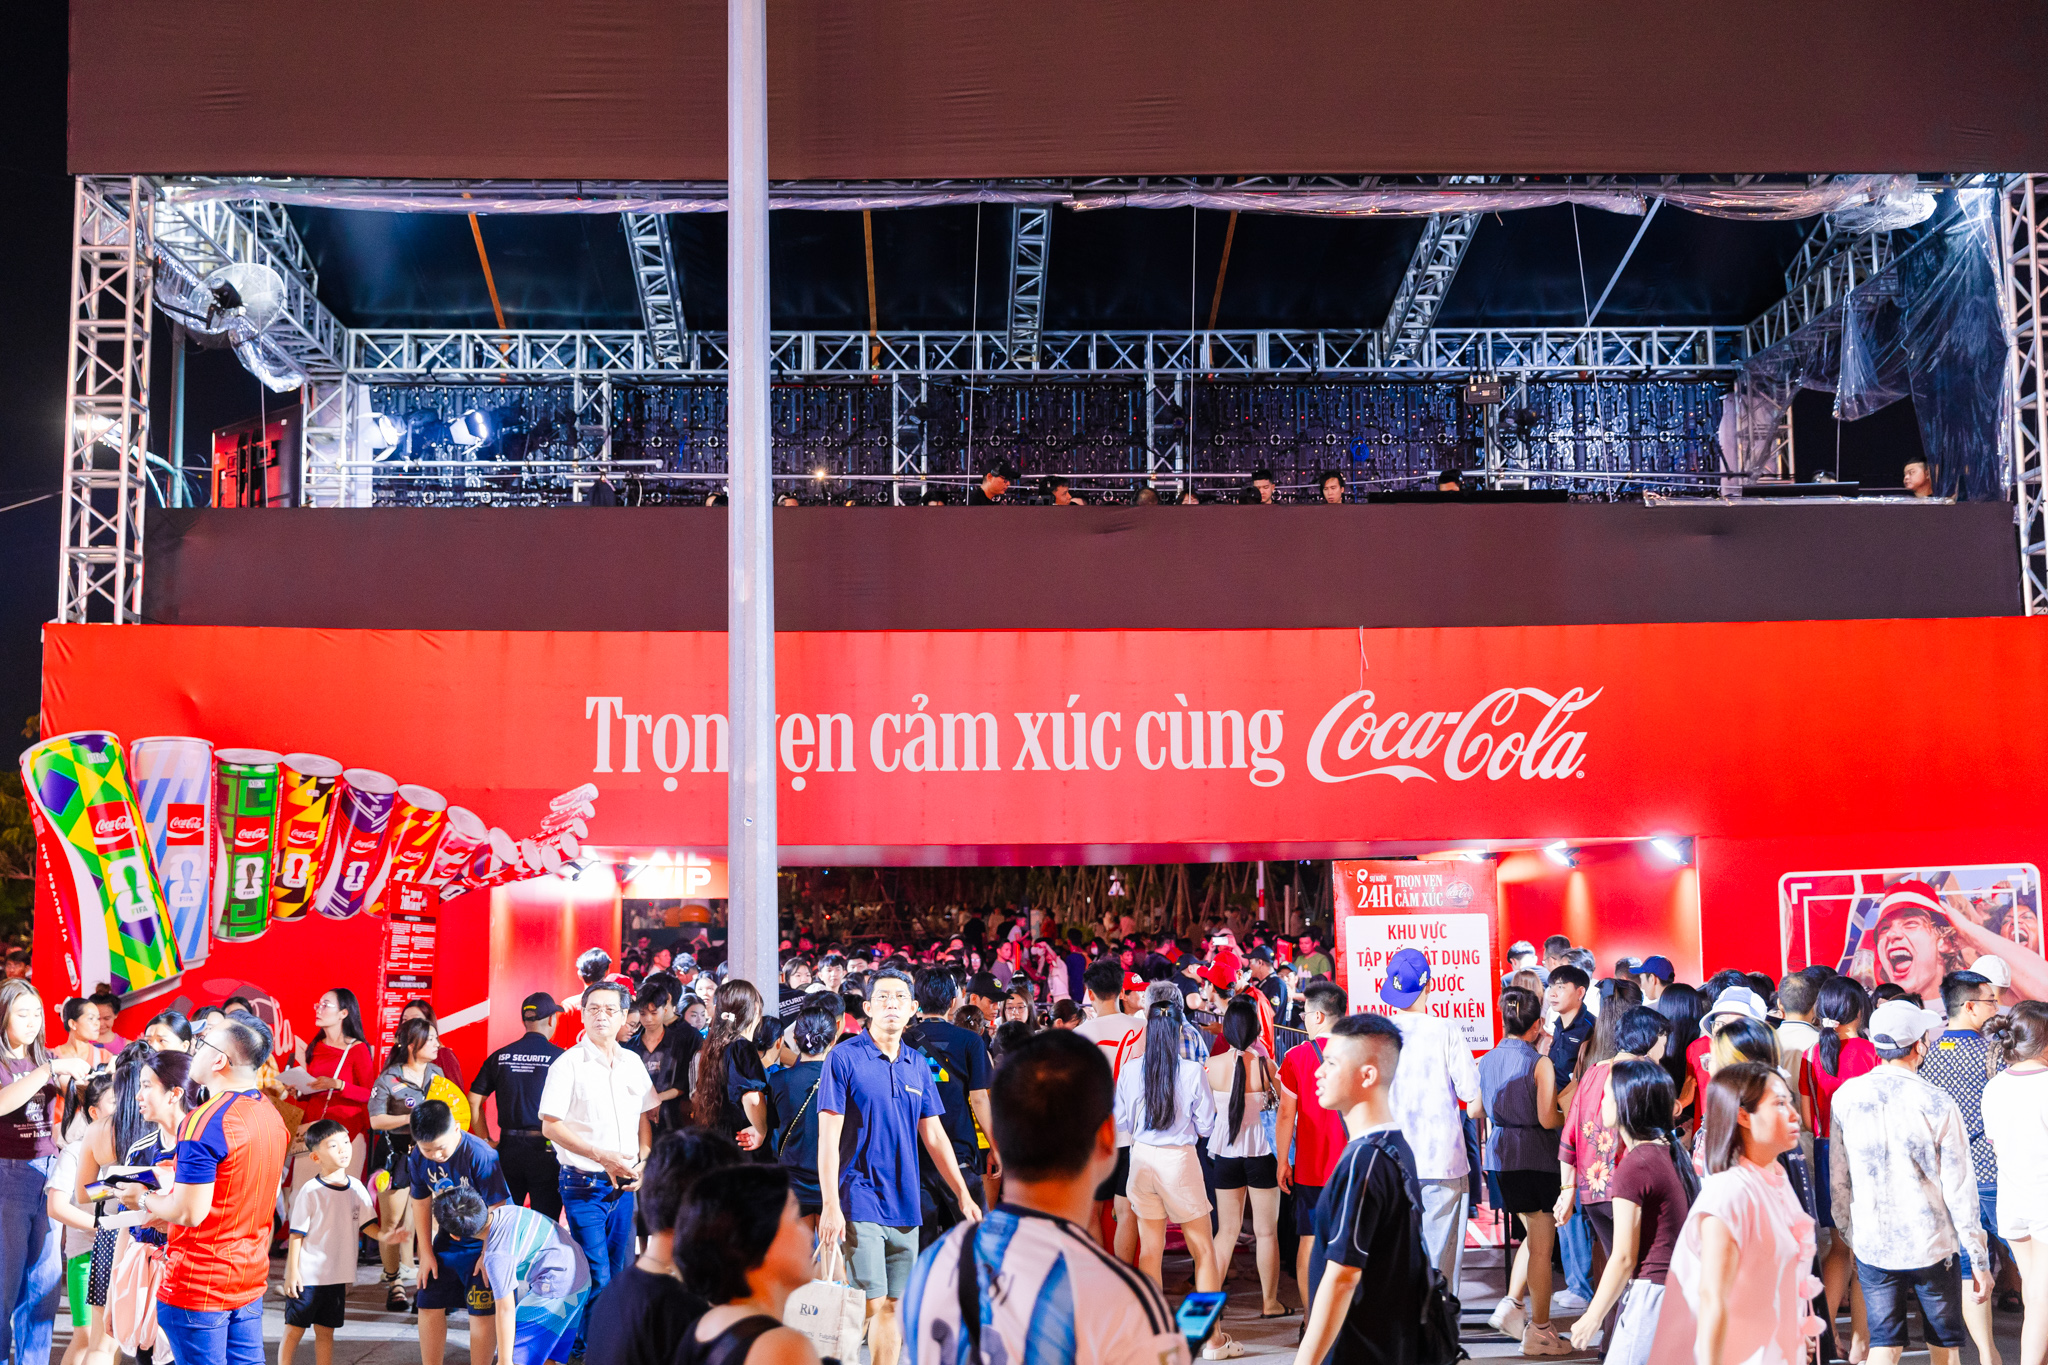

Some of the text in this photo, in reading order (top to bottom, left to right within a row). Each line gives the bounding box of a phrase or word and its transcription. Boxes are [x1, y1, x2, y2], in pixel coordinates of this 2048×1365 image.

[585, 696, 728, 792] Trọn
[774, 712, 857, 792] ẹn
[869, 693, 1001, 773] cảm
[1012, 694, 1122, 771] xúc
[1135, 693, 1286, 788] cùng
[1393, 874, 1443, 892] TRỌN VẸN
[1357, 884, 1394, 908] 24H
[1394, 889, 1420, 908] CẢM
[131, 905, 149, 916] FIFA
[1387, 920, 1448, 944] KHU VỰC
[1356, 946, 1382, 972] TẬP
[1442, 949, 1481, 970] DỤNG
[779, 995, 806, 1009] SECURIT
[1454, 997, 1485, 1023] KIỆN
[498, 1053, 552, 1063] ISP SECURITY
